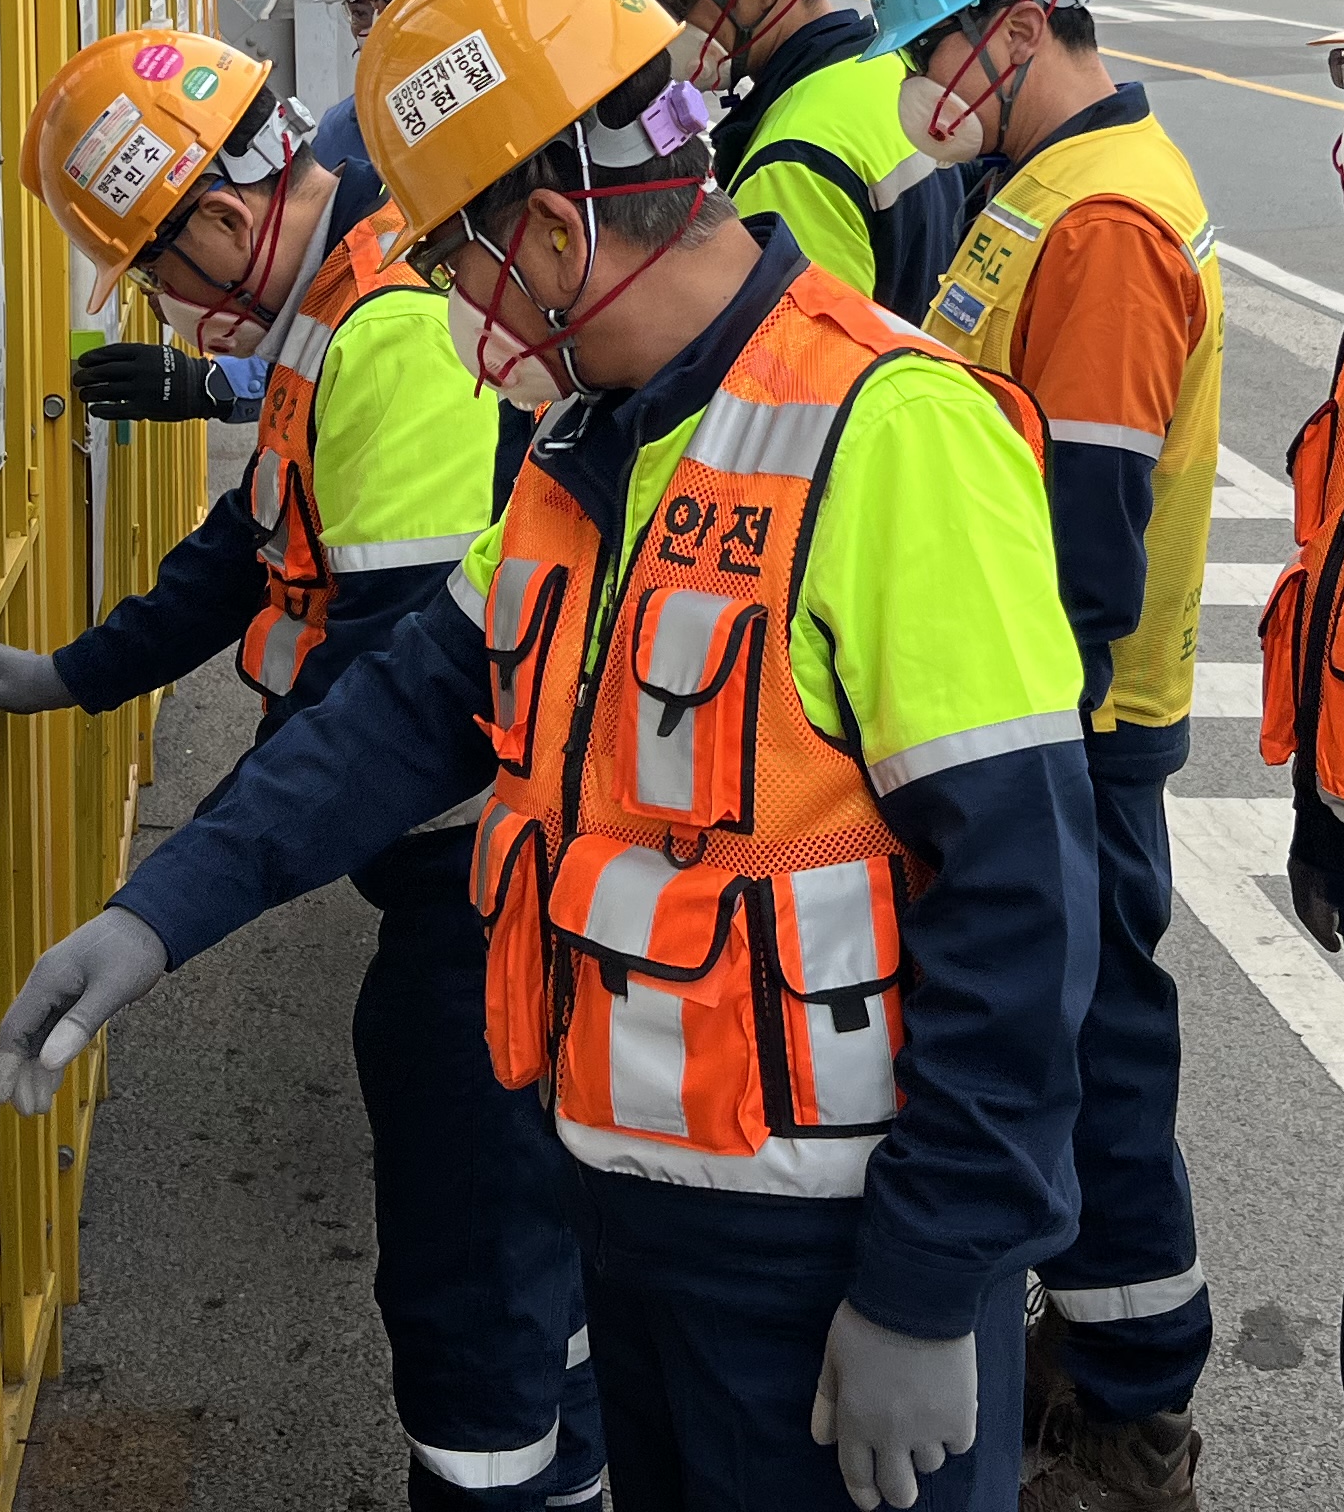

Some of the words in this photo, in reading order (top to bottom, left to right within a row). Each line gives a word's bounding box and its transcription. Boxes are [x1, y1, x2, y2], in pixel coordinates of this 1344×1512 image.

[391, 39, 482, 116] 광양양극재1공장
[402, 106, 426, 136] 정
[430, 83, 459, 116] 현
[464, 61, 495, 93] 철
[97, 165, 122, 194] 양극재
[110, 185, 130, 204] 석
[124, 165, 145, 187] 민
[143, 146, 160, 164] 수
[658, 494, 772, 576] 안전
